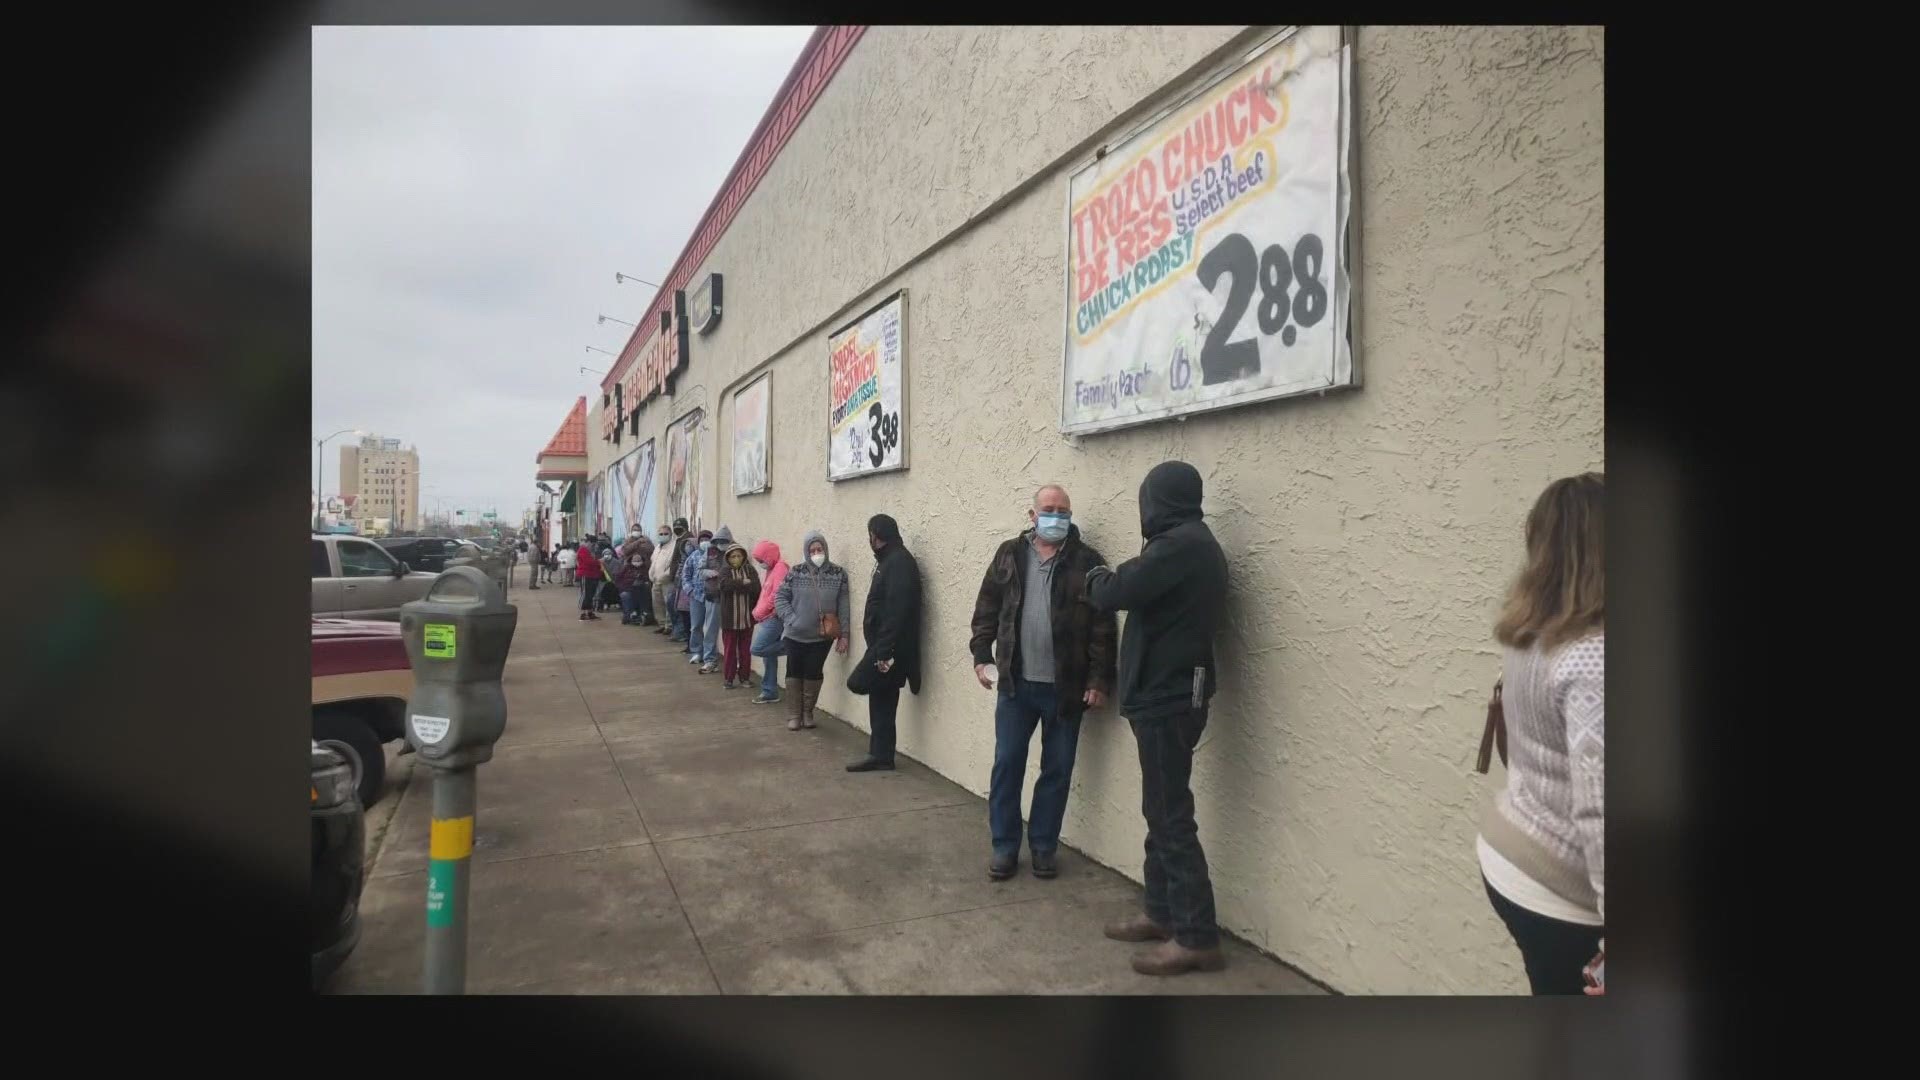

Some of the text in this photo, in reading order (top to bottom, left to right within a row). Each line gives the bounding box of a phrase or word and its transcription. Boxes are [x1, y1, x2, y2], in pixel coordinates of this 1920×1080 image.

[1073, 66, 1277, 266] TROZO CHUCK
[1225, 151, 1264, 201] beef
[1077, 197, 1172, 304] DE RES
[1077, 230, 1194, 335] CHUCK ROAST
[1075, 374, 1118, 409] Family
